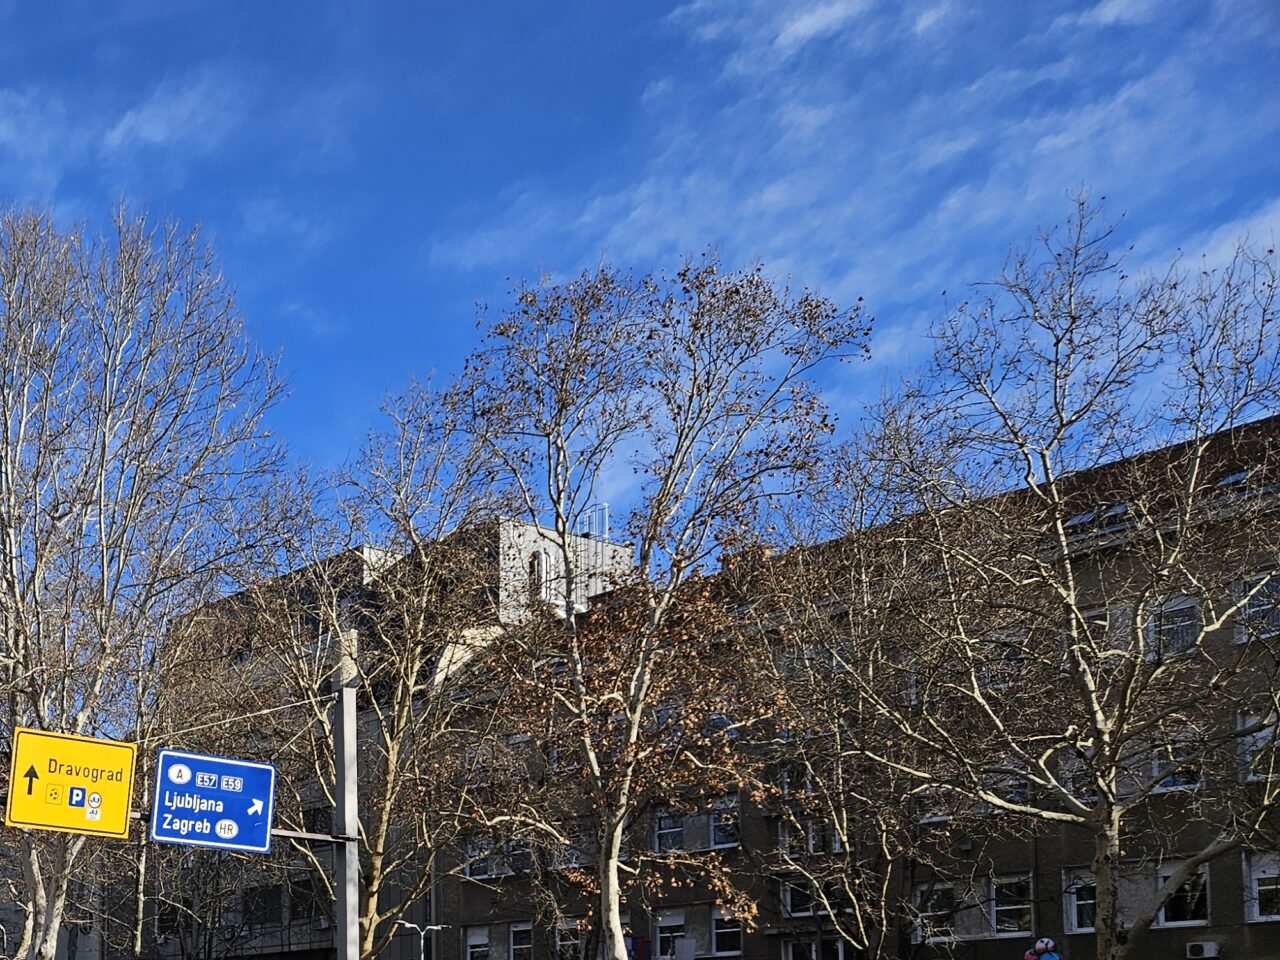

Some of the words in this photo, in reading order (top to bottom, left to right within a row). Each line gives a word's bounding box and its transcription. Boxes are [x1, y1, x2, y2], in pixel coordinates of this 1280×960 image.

[48, 758, 123, 783] Dravograd
[176, 768, 183, 780] A
[197, 774, 217, 787] E57
[222, 777, 241, 790] E59
[164, 790, 224, 813] Ljubljana
[162, 813, 211, 835] Zagreb
[219, 823, 234, 835] HR
